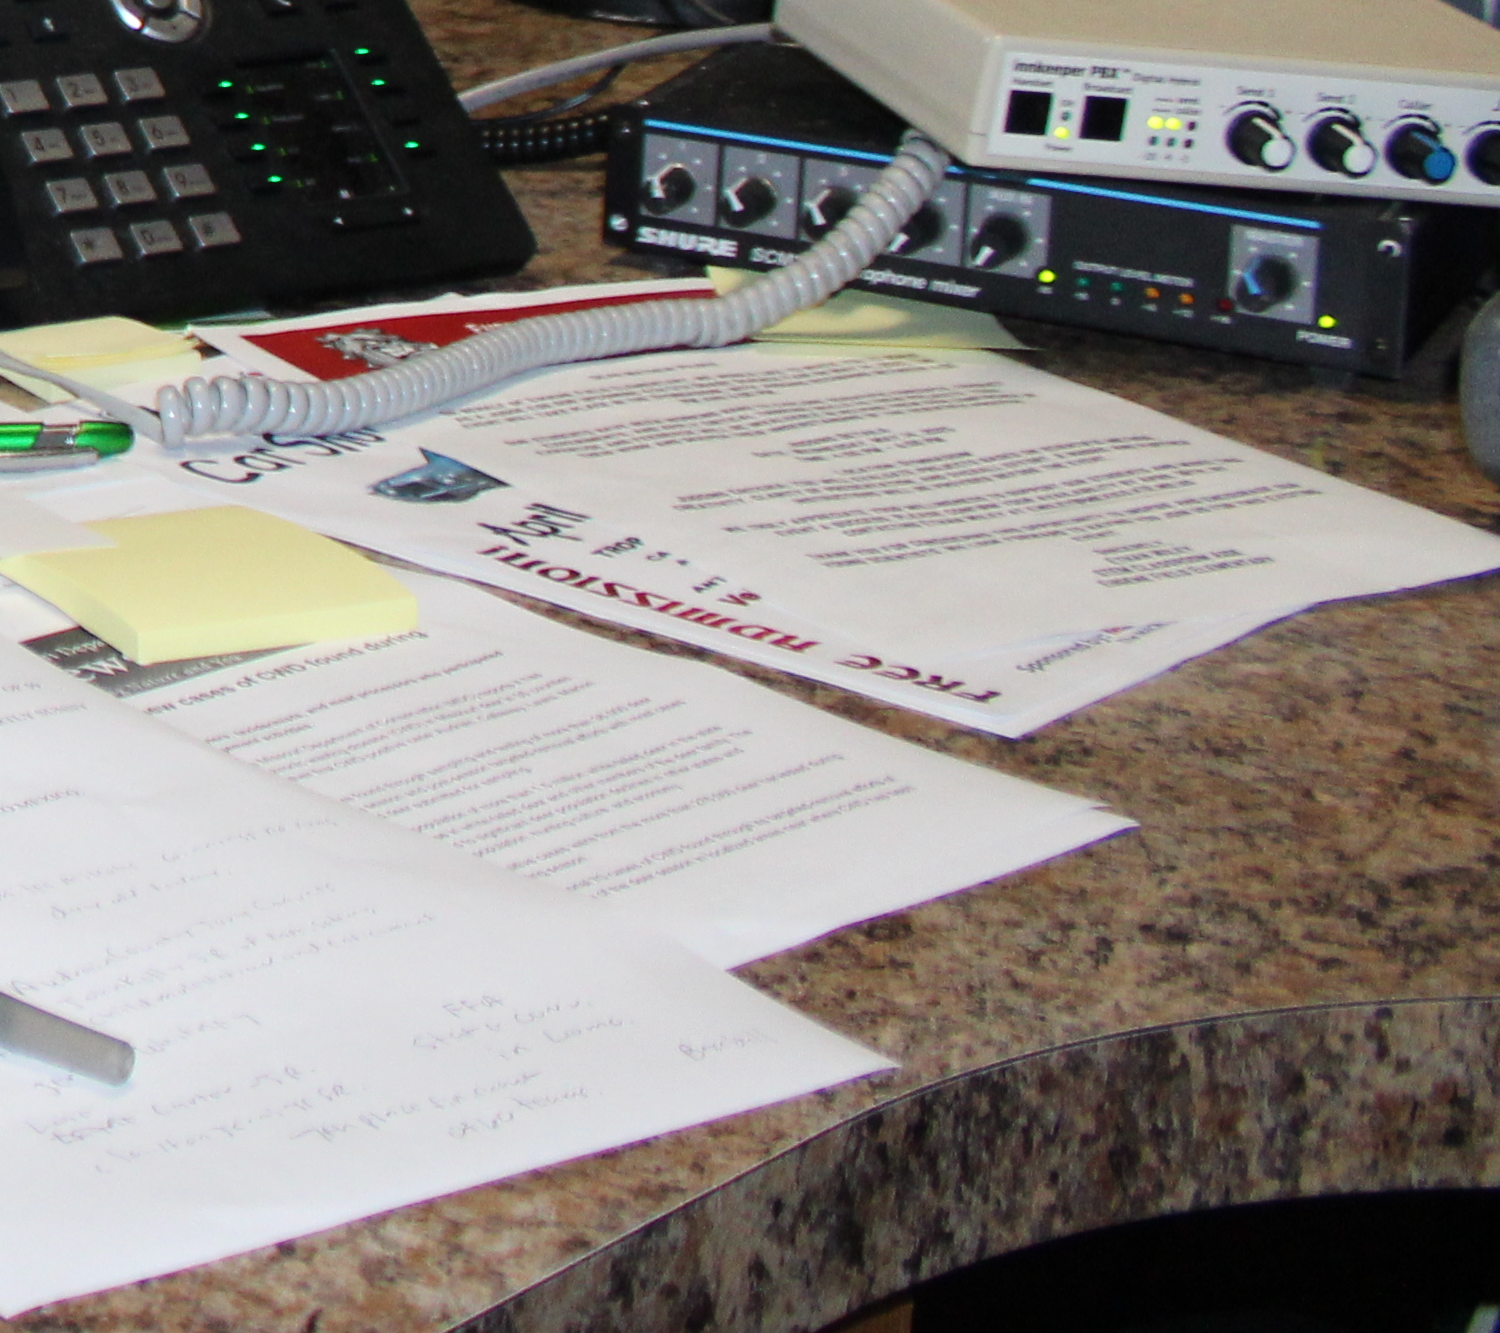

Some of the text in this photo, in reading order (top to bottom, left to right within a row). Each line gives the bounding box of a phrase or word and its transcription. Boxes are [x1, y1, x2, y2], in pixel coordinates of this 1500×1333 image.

[1013, 60, 1088, 77] innkeeper
[636, 226, 738, 259] SHURE
[931, 277, 982, 299] mixer
[180, 446, 306, 485] Car
[476, 502, 592, 547] April
[178, 630, 431, 707] cases of CWD found during
